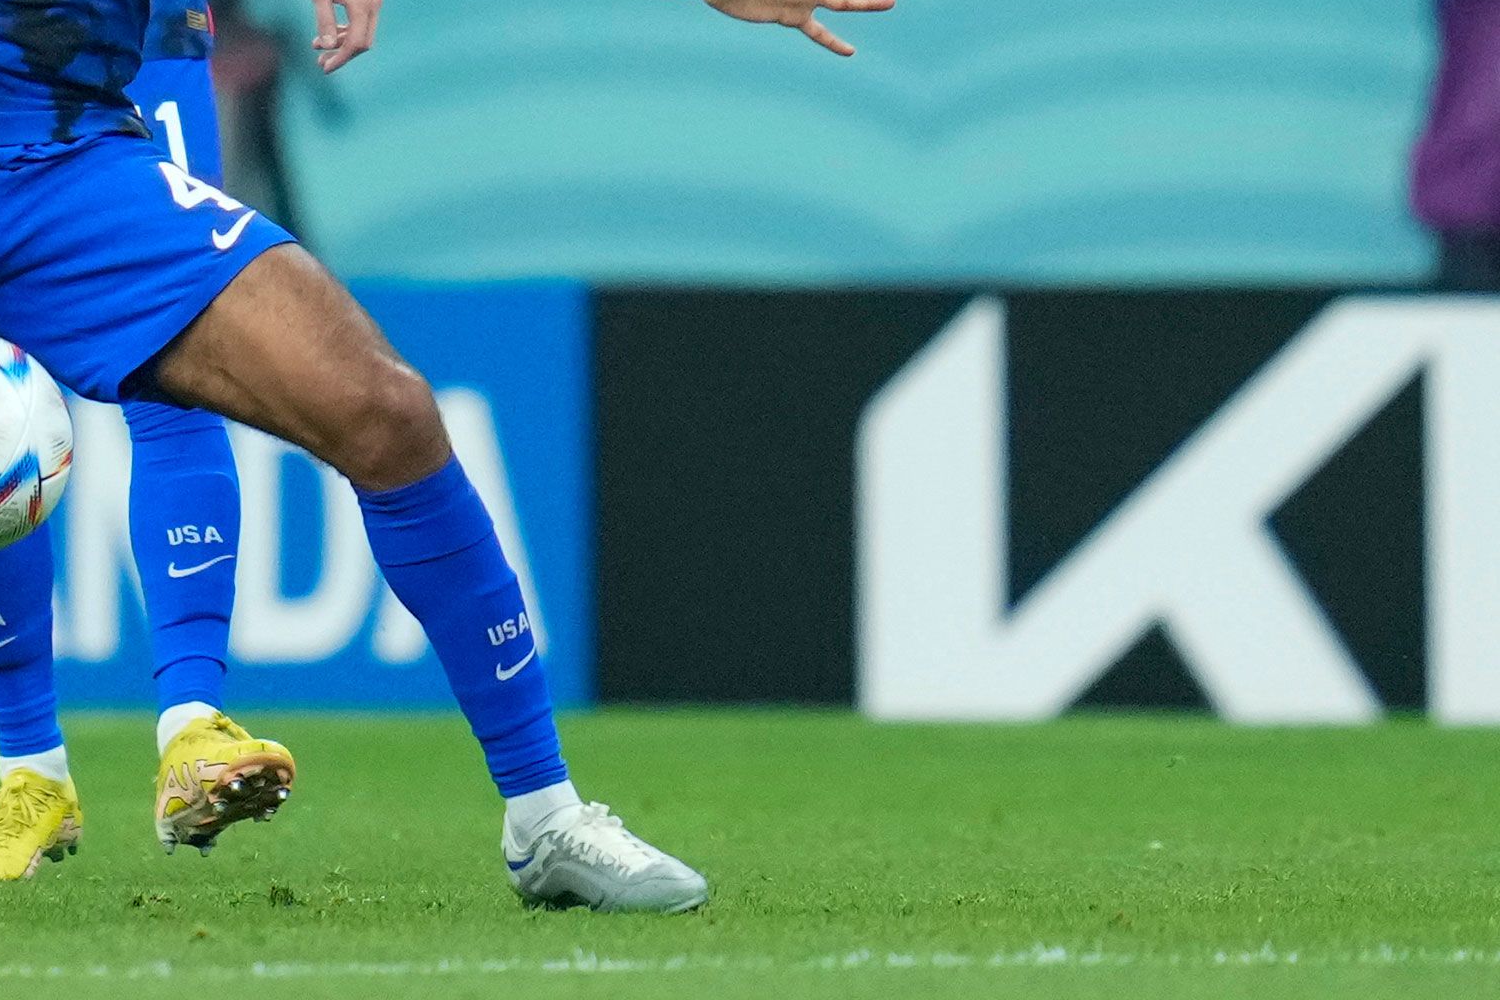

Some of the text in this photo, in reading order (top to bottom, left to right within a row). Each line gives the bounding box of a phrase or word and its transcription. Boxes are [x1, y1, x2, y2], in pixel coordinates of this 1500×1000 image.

[158, 161, 244, 211] 4
[167, 524, 224, 546] USA
[487, 611, 530, 646] USA
